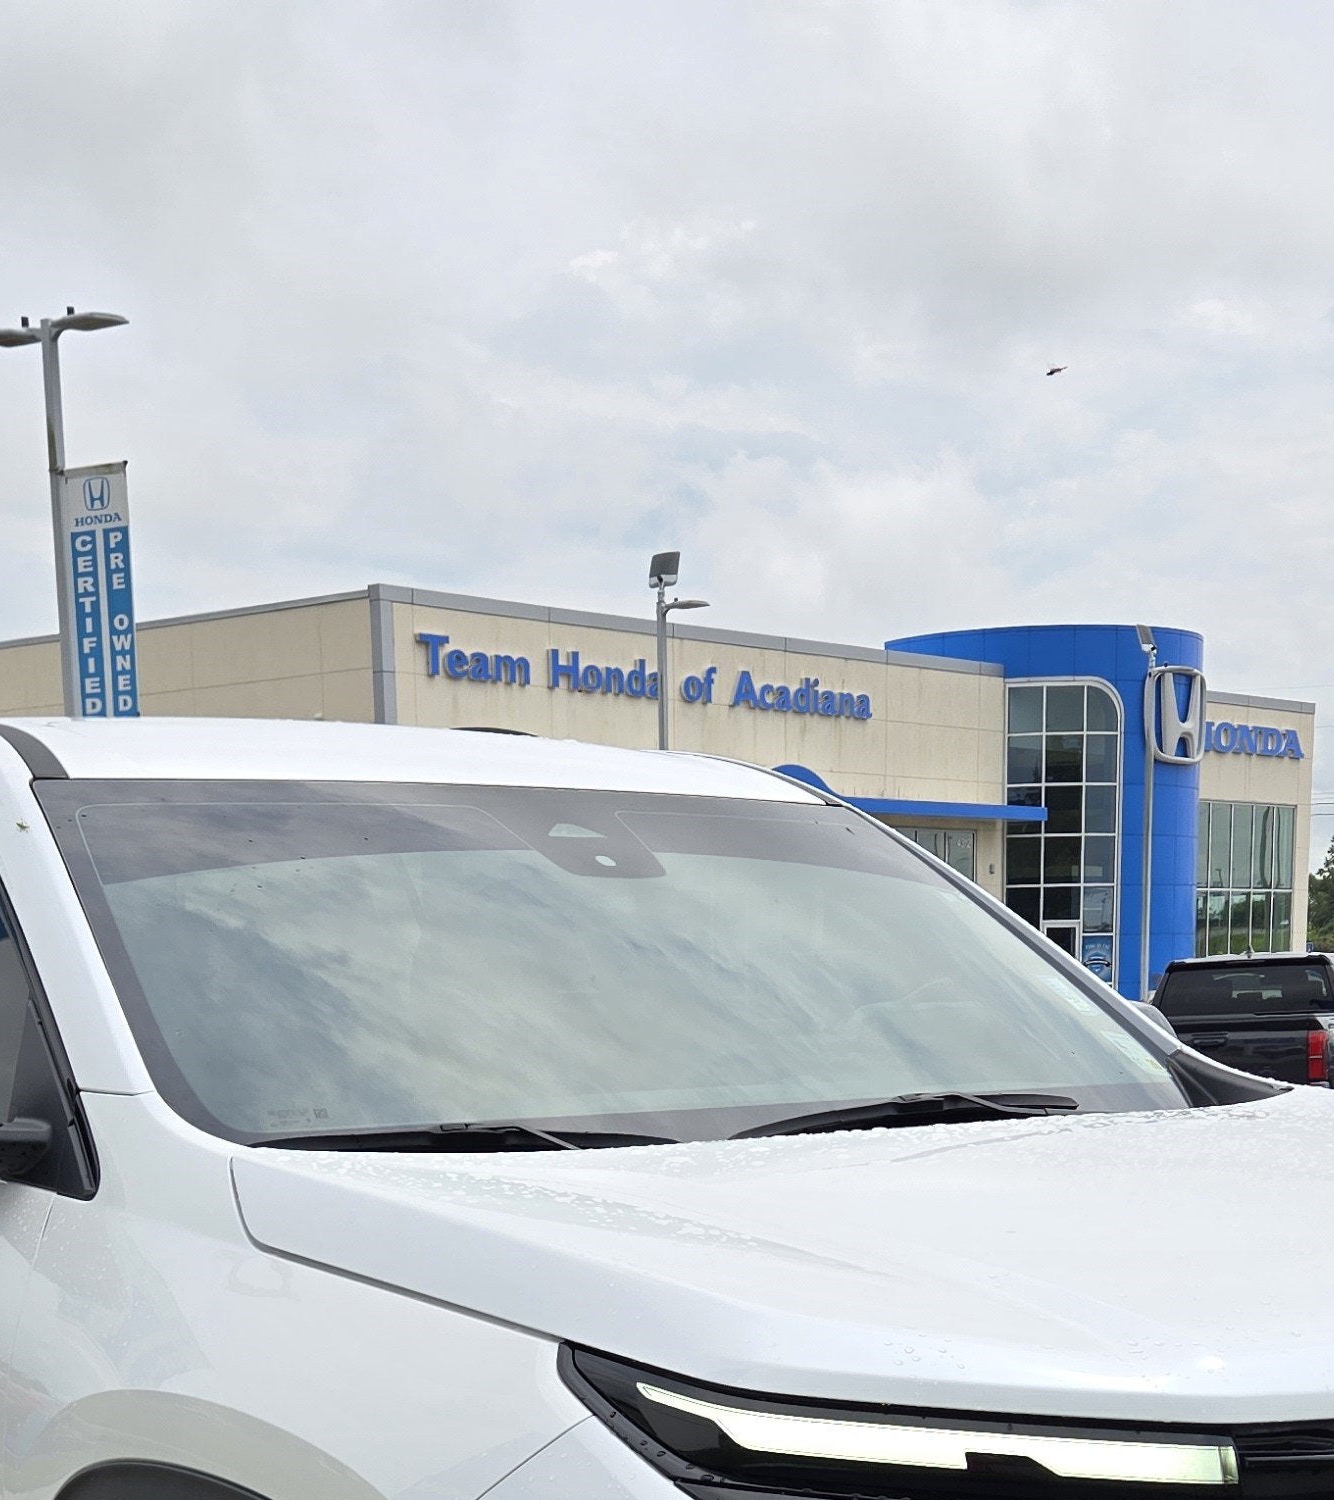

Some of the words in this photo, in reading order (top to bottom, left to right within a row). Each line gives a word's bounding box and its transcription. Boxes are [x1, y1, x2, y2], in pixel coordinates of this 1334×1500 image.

[74, 512, 122, 528] HONDA
[109, 531, 126, 590] PRE
[75, 534, 103, 716] CERTIFIED
[112, 614, 133, 713] OWNED
[415, 632, 531, 686] Team
[548, 648, 661, 699] Honda
[680, 666, 718, 704] of
[730, 670, 873, 720] Acadiana
